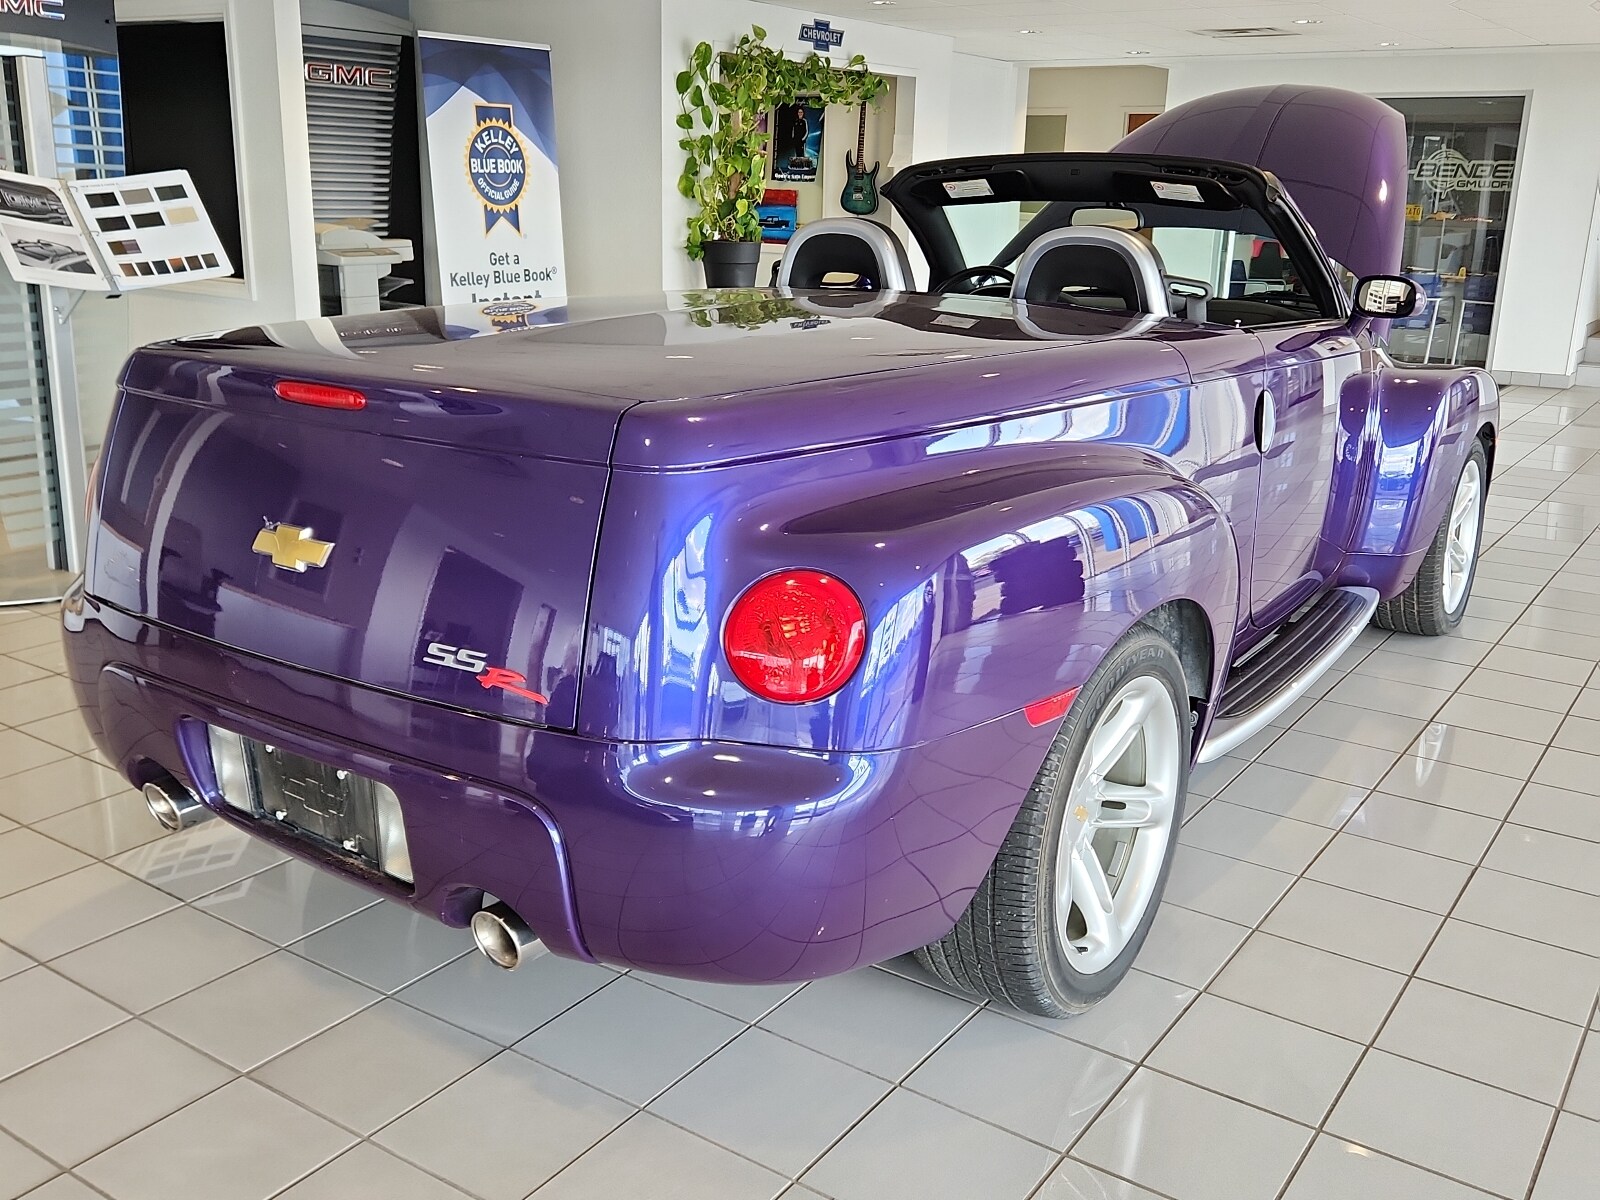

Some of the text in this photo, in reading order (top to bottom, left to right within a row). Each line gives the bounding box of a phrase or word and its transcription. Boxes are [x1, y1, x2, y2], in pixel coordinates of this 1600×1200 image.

[802, 28, 841, 43] CHEVROLET
[304, 62, 392, 89] GMC
[474, 129, 519, 154] KELLEY
[470, 158, 524, 174] BLUE BOOK
[1416, 162, 1515, 179] BENDE
[477, 177, 520, 201] OFFICIAL GUIDE
[1456, 180, 1512, 189] GMWOR
[489, 252, 520, 266] Get a
[450, 272, 490, 288] Kelley
[493, 270, 521, 284] Blue
[1086, 648, 1165, 729] GOODYEAR
